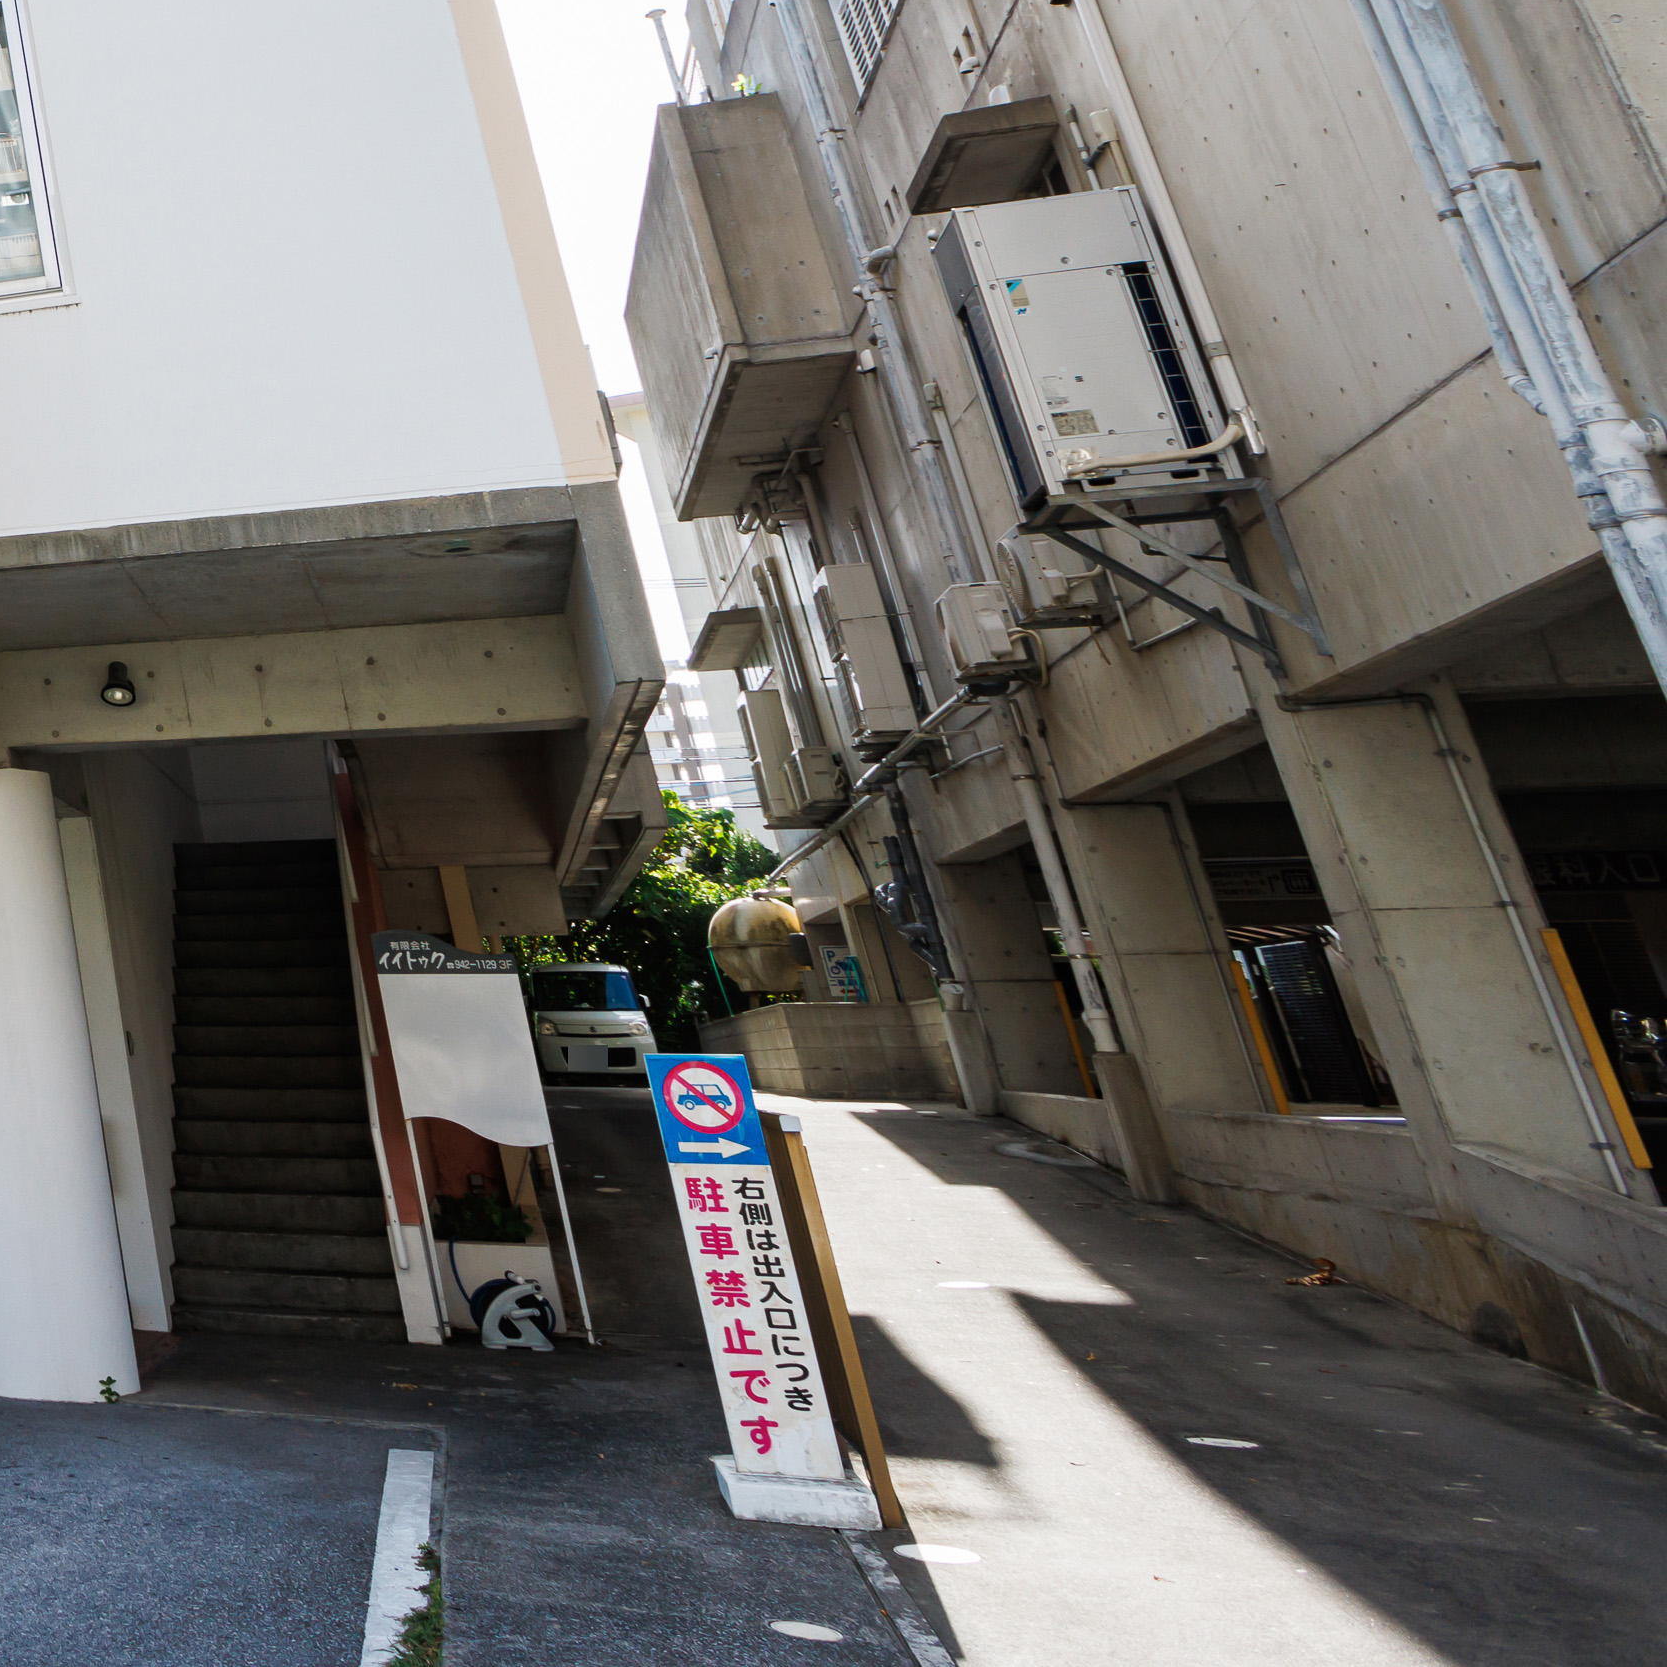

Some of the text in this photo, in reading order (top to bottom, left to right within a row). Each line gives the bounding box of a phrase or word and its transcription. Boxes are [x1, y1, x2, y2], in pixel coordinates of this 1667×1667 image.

[379, 951, 513, 970] イイトゥク 942-1129 3F
[389, 941, 431, 951] 有限会社
[684, 1176, 779, 1455] 駐車禁止です
[731, 1176, 813, 1412] 右側は出入口につき
